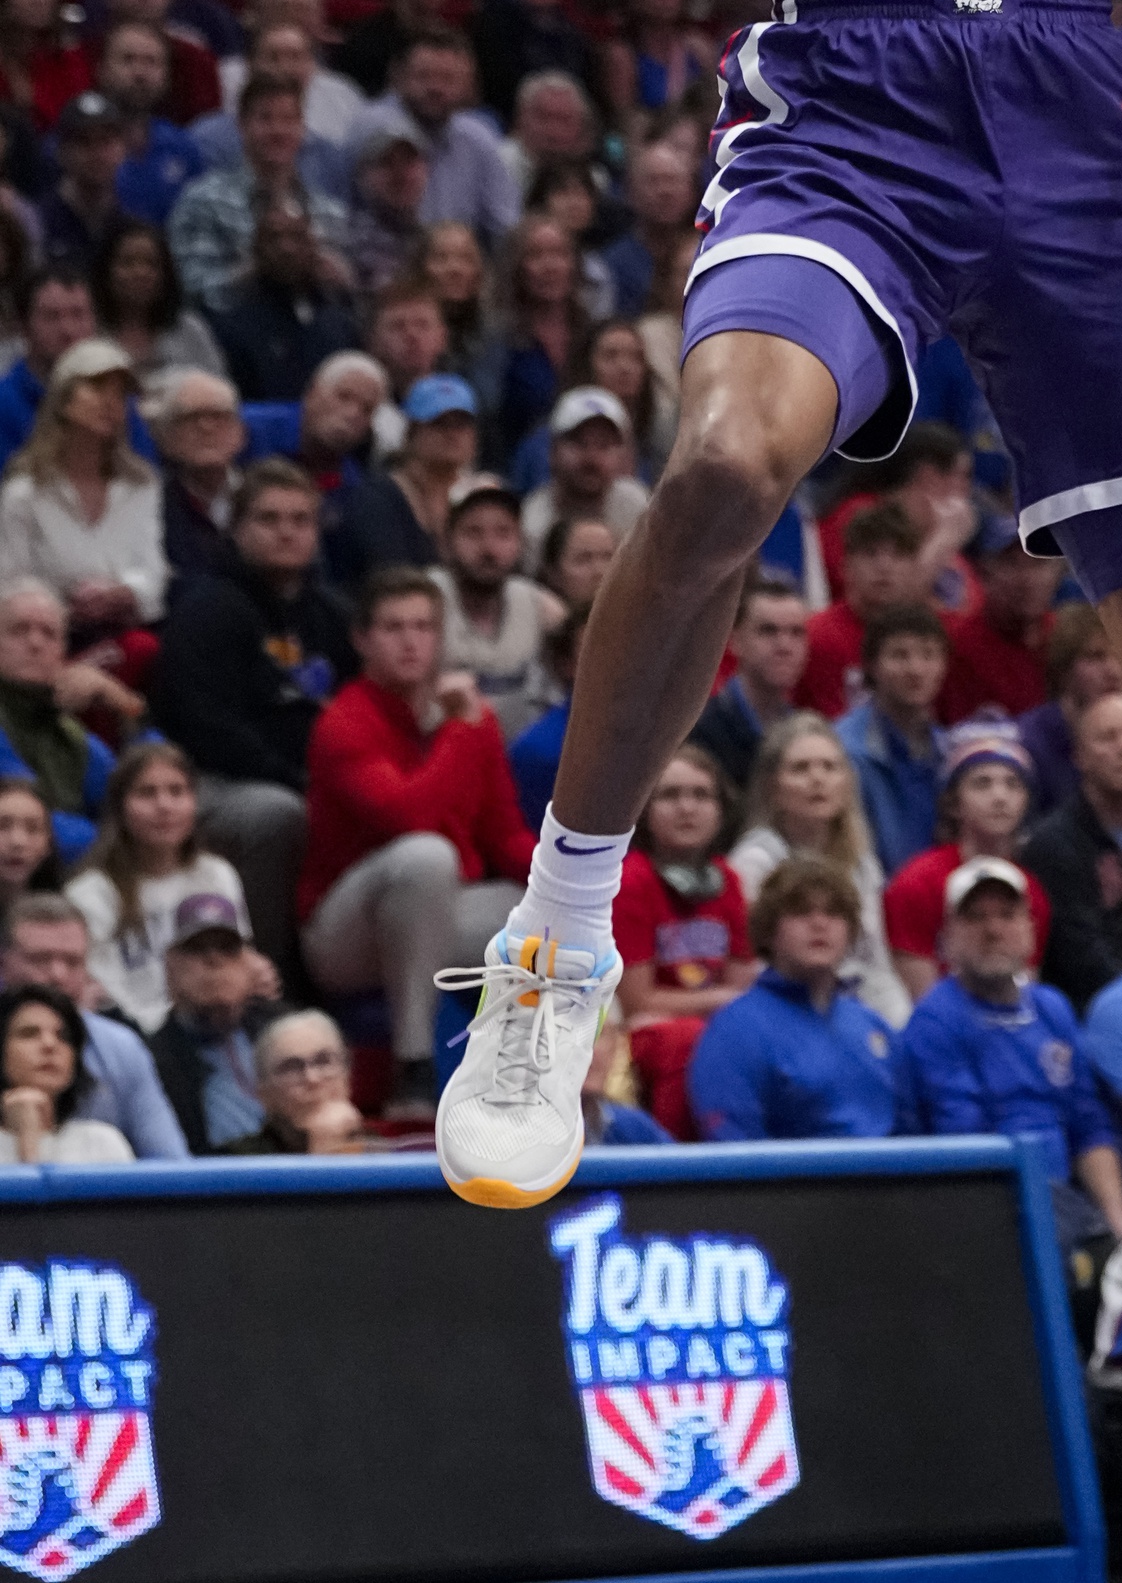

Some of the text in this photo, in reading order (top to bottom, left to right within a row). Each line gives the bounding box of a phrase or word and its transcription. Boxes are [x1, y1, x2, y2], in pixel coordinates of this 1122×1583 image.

[551, 1200, 787, 1334] Team
[0, 1265, 151, 1359] am
[0, 1360, 152, 1413] PACT
[571, 1330, 788, 1384] IMPACT
